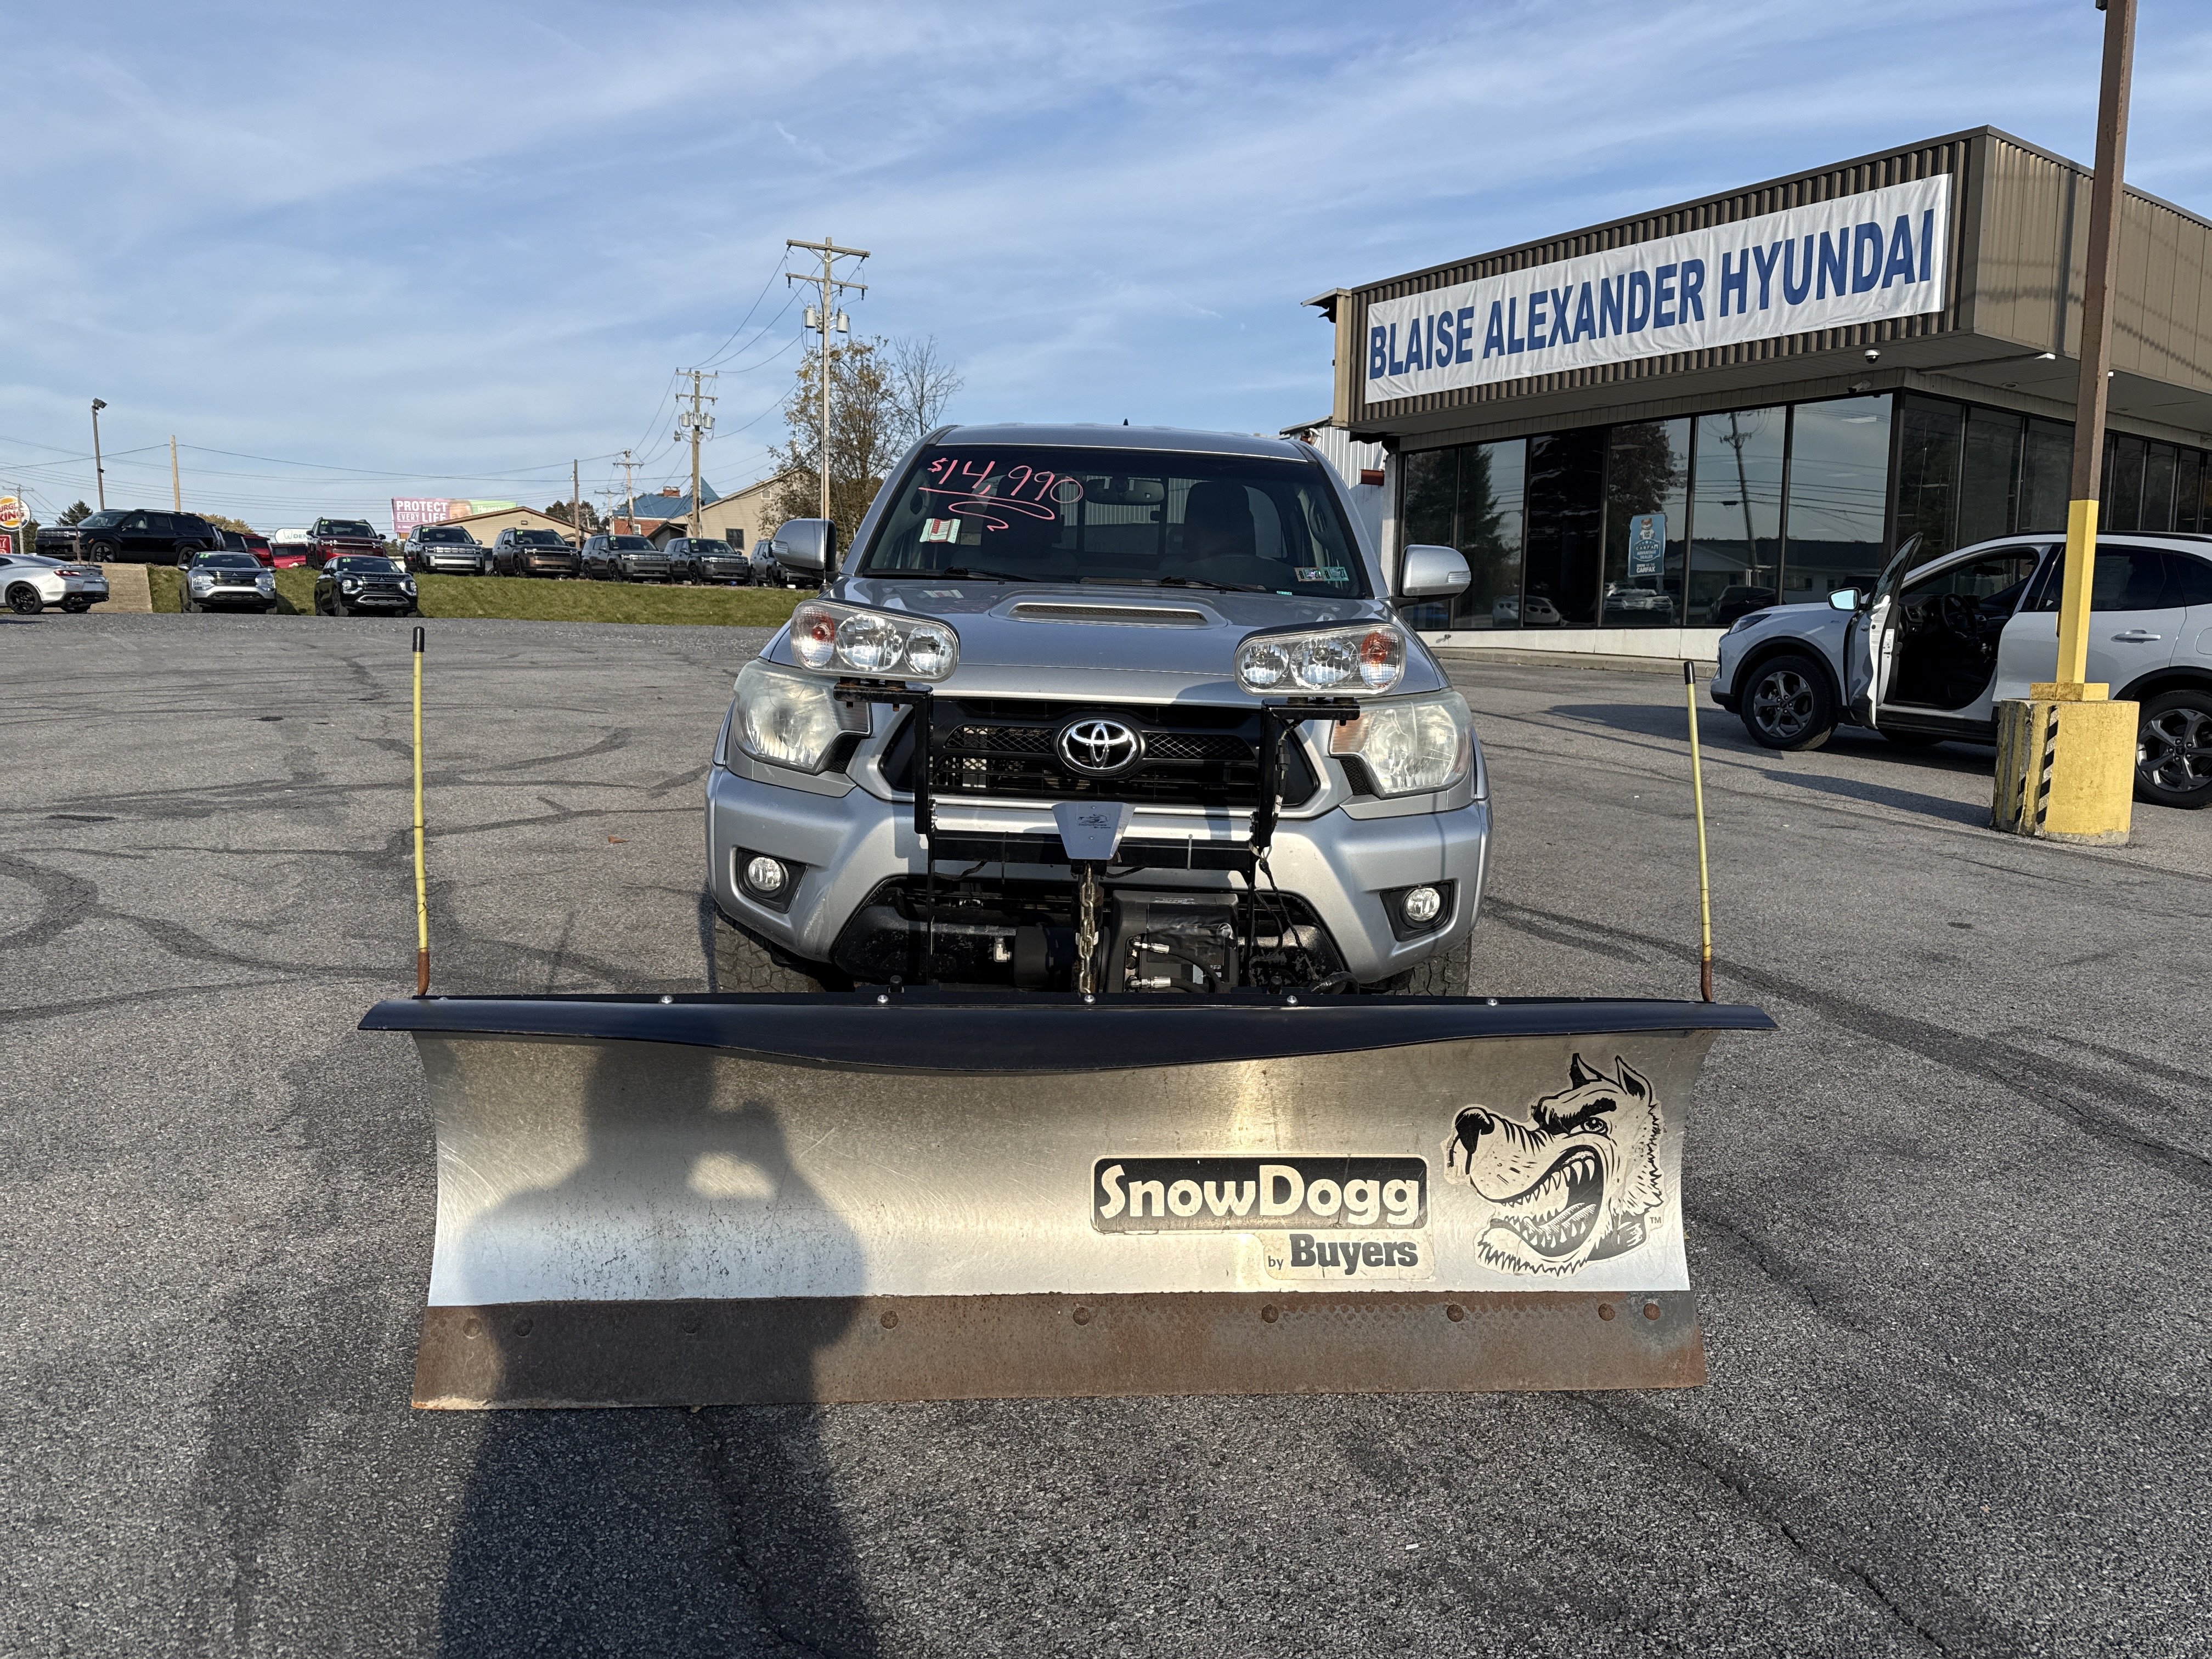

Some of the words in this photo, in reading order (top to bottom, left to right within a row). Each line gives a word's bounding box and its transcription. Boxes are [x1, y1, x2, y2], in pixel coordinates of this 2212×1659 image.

[1369, 306, 1474, 380] BLAISE
[1483, 258, 1705, 359] ALEXANDER
[1719, 208, 1934, 318] HYUNDAI
[927, 458, 1084, 504] $14,990
[396, 500, 447, 512] PROTECT
[422, 512, 446, 522] LIFE
[1099, 1164, 1419, 1226] SnowDogg
[1268, 1255, 1283, 1270] by
[1289, 1233, 1418, 1276] Buyers
